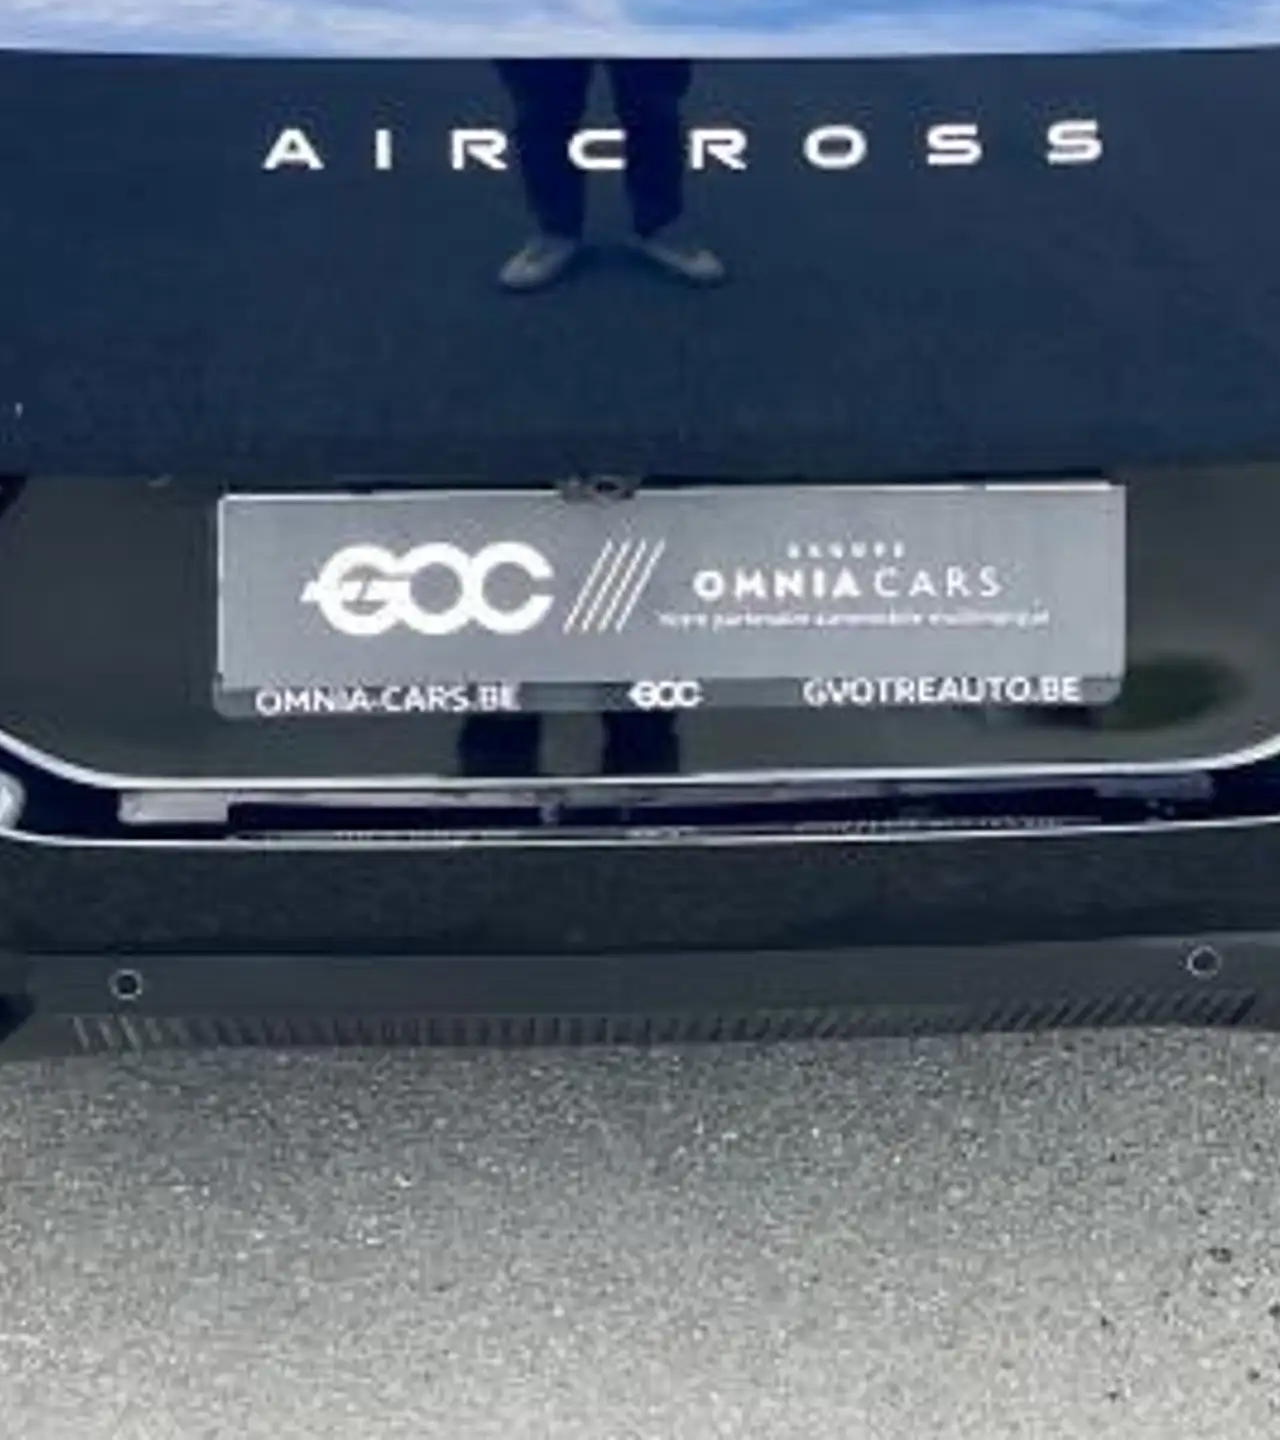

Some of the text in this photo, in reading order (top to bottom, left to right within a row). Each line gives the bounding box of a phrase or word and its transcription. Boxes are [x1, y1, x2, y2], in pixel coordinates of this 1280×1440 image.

[263, 120, 1103, 171] AIRCROSS
[300, 541, 554, 636] GOC
[692, 566, 1004, 601] OMNIA CARS
